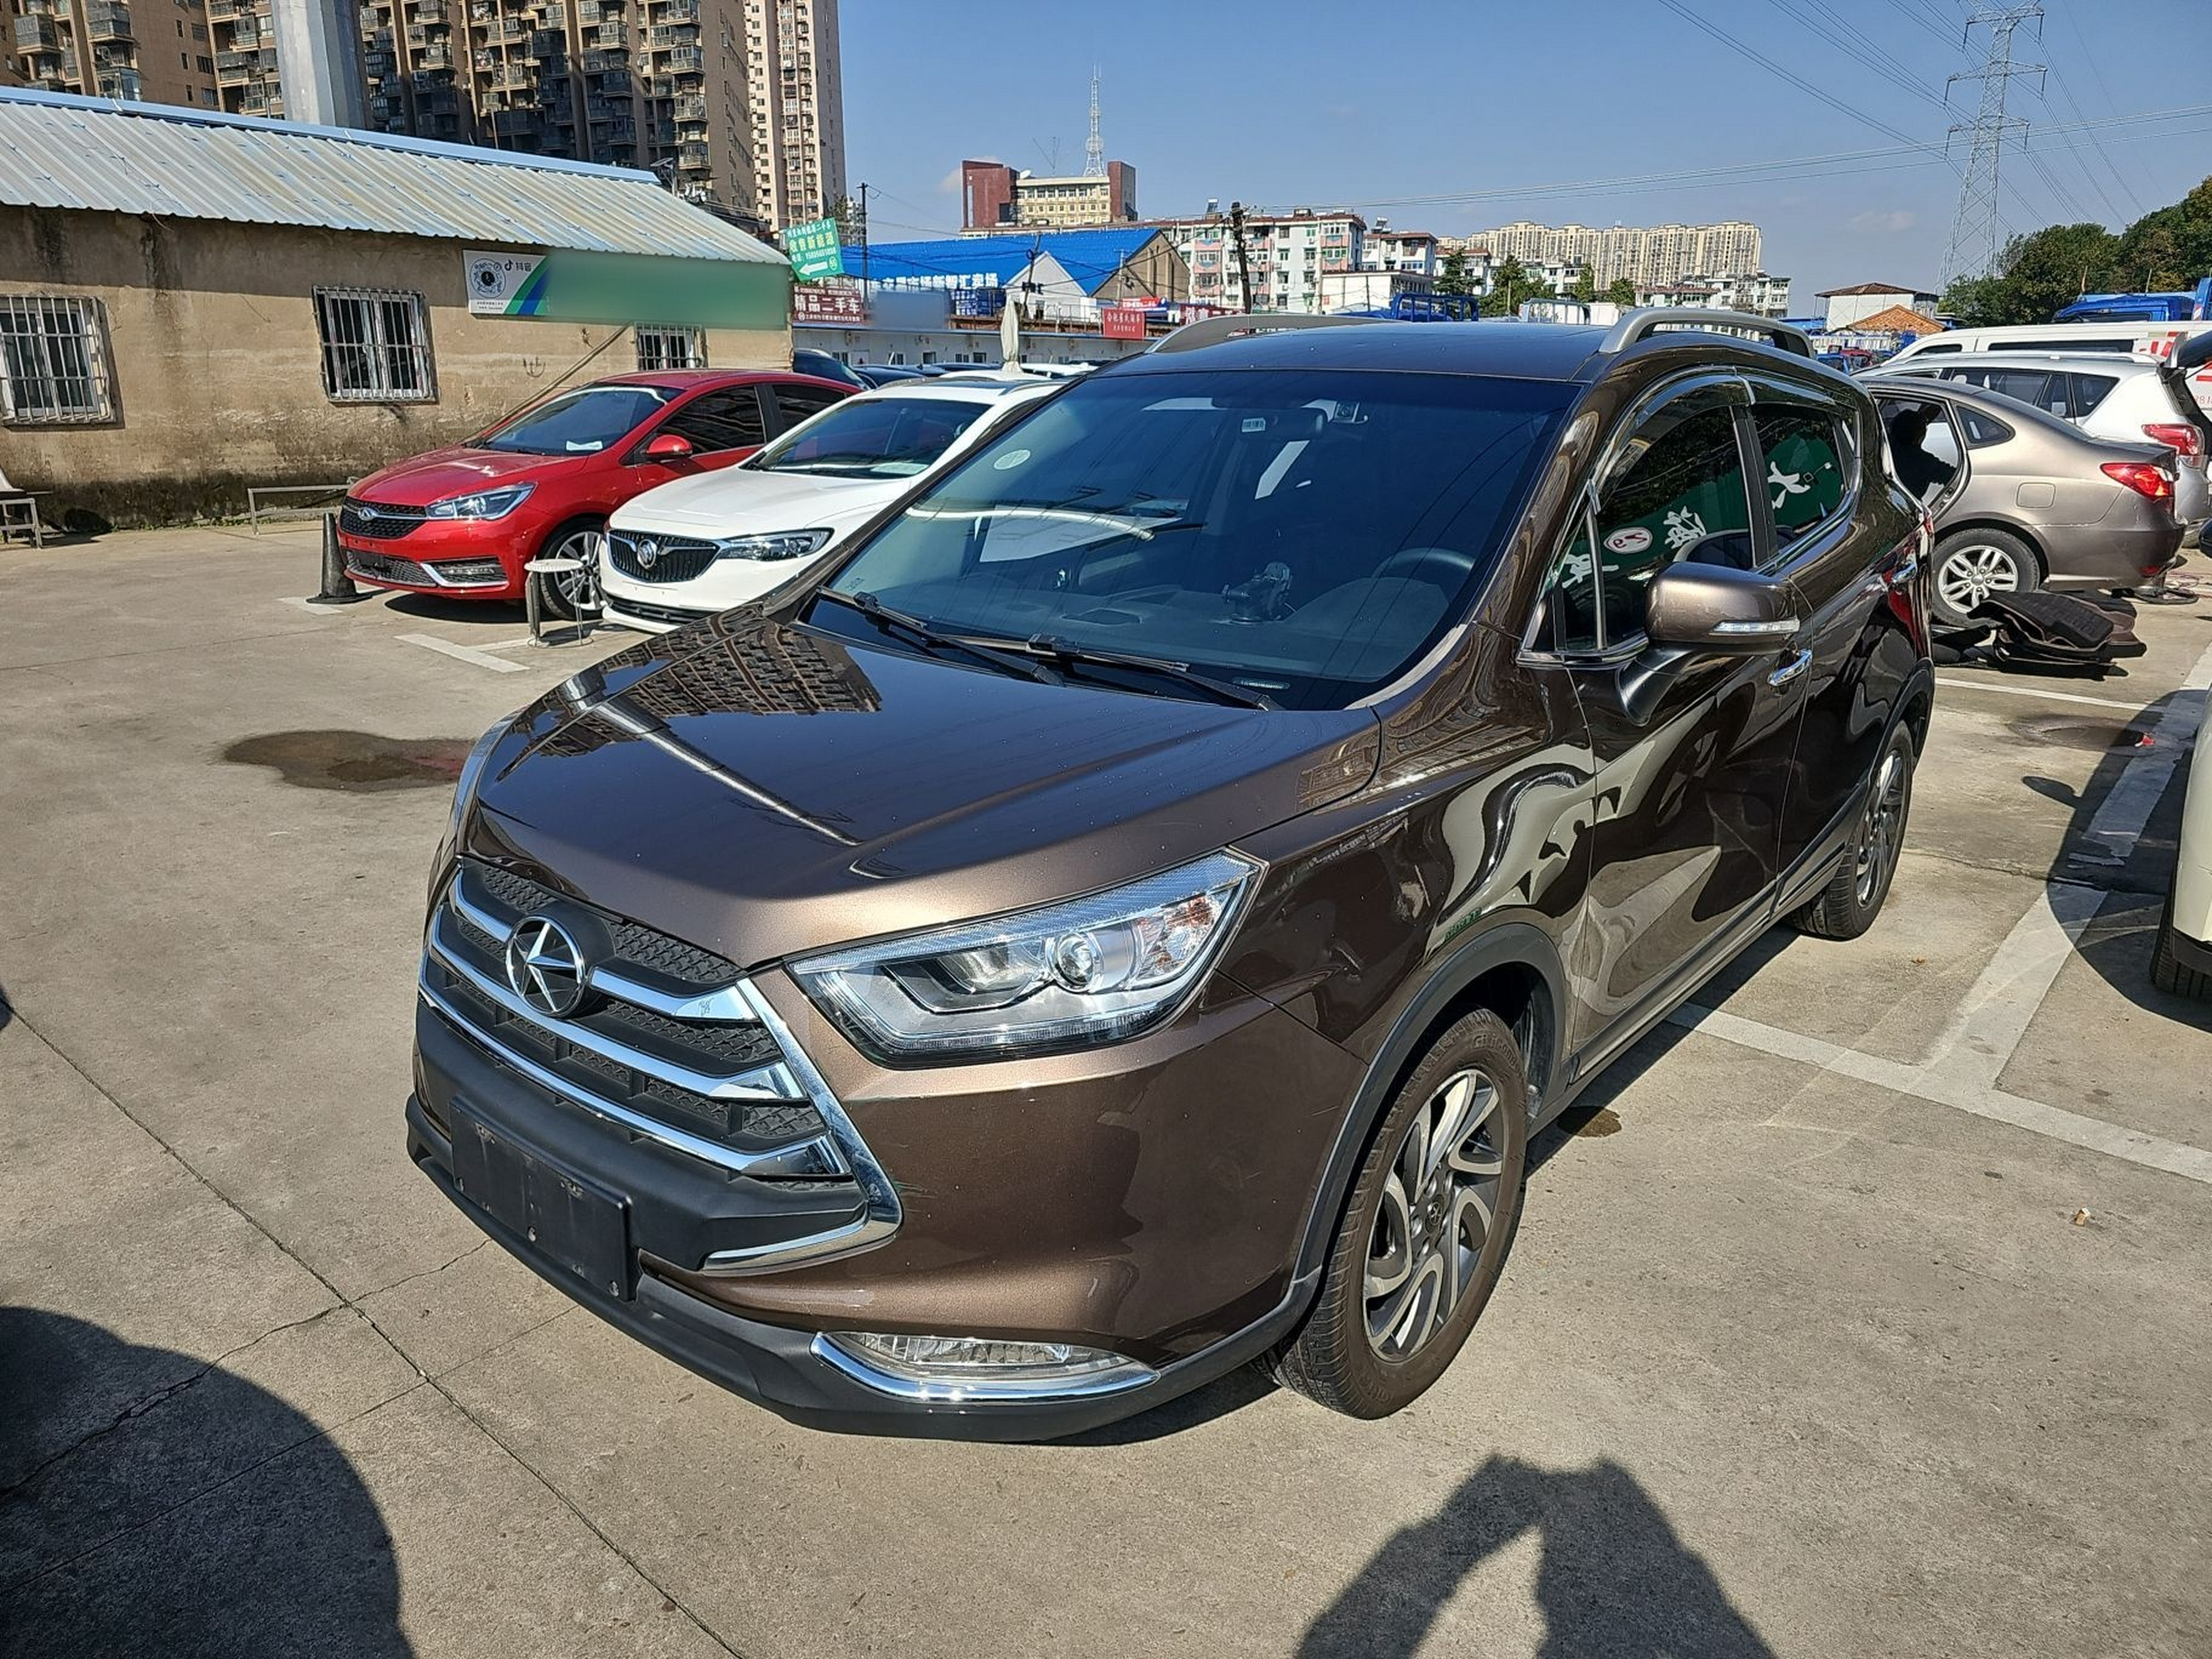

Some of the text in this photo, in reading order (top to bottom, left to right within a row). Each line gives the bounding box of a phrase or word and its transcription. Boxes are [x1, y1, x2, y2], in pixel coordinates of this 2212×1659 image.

[516, 262, 532, 271] 抖音
[794, 294, 860, 314] 精品二手车
